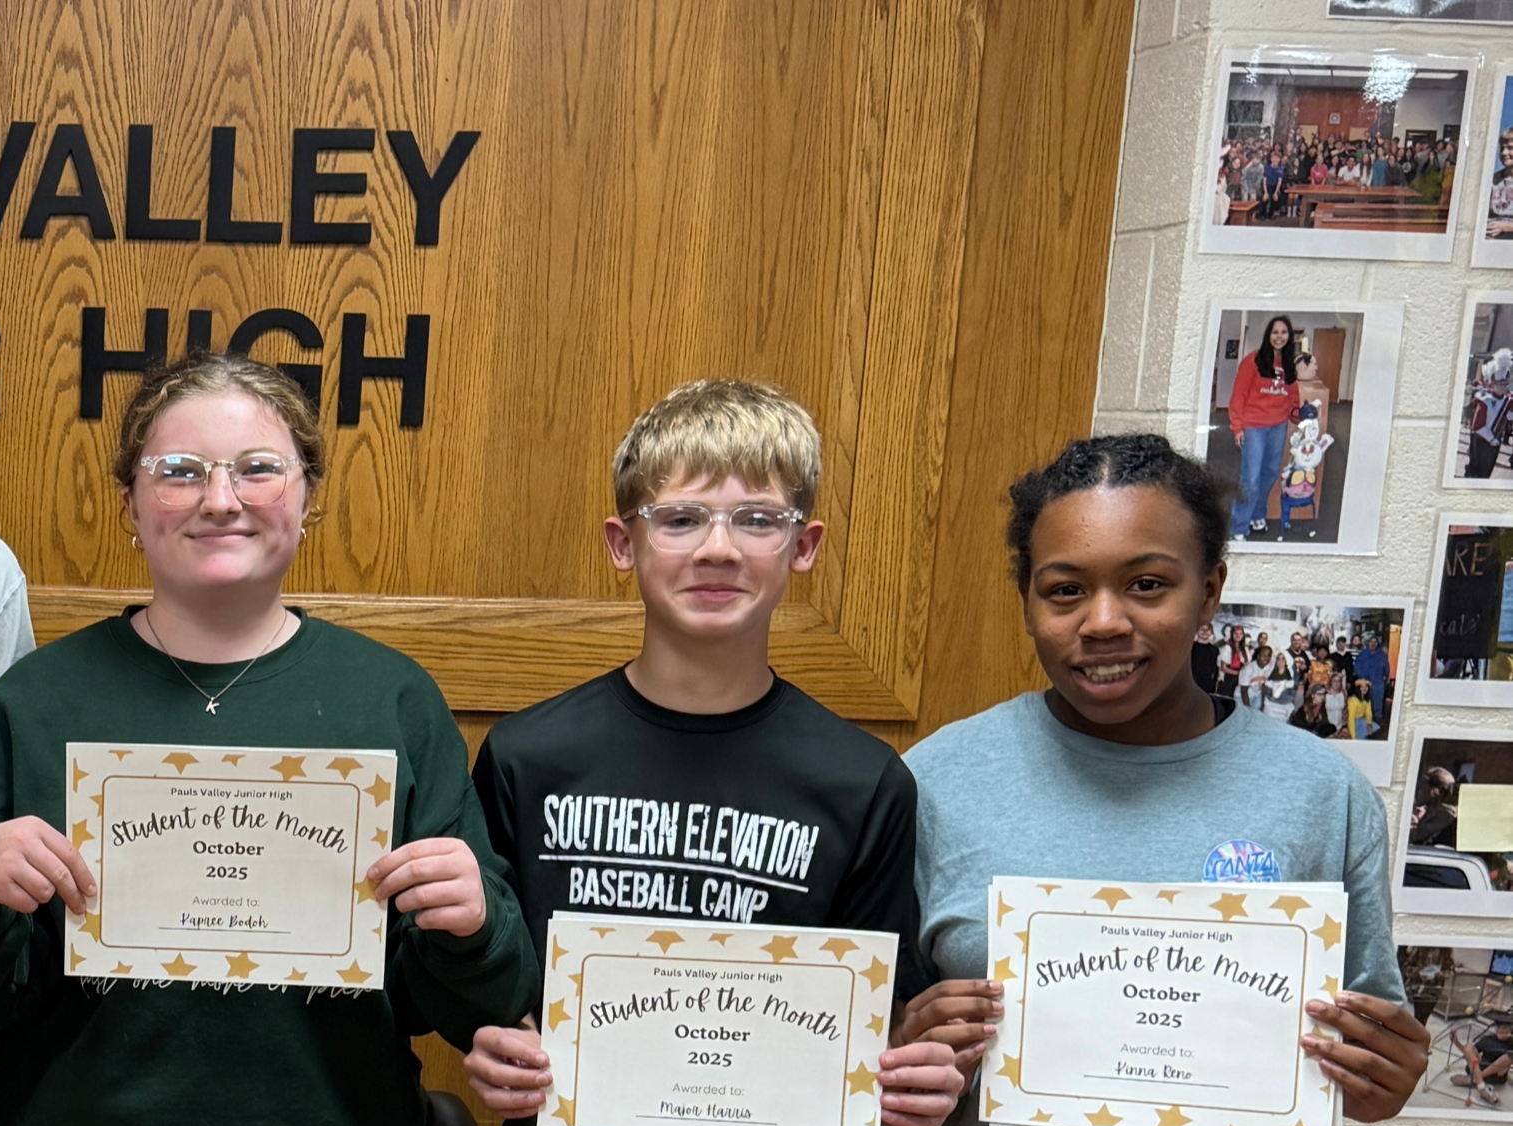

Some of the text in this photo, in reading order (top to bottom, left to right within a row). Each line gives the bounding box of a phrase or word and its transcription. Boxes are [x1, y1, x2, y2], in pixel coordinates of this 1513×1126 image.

[171, 788, 293, 800] Pauls Valley Junior High
[111, 805, 348, 854] Student of the Month
[544, 795, 819, 880] SOUTHERN ELEVATION
[193, 841, 264, 855] October
[206, 866, 248, 880] 2025
[569, 867, 693, 913] BASEBALL
[193, 896, 259, 907] Awarded to:
[1101, 926, 1233, 943] Pauls Valley Junior High
[654, 968, 782, 983] Pauls Valley Junior High
[1036, 946, 1294, 1004] Student of the Month
[1123, 984, 1201, 1002] October
[589, 987, 841, 1042] Student of the Month
[1136, 1011, 1182, 1028] 2025
[674, 1024, 751, 1042] October
[1120, 1043, 1194, 1058] Awarded to:
[687, 1052, 733, 1067] 2025
[1163, 1064, 1192, 1079] Reno
[672, 1083, 744, 1096] Awarded to:
[660, 1100, 751, 1119] Major Harris
